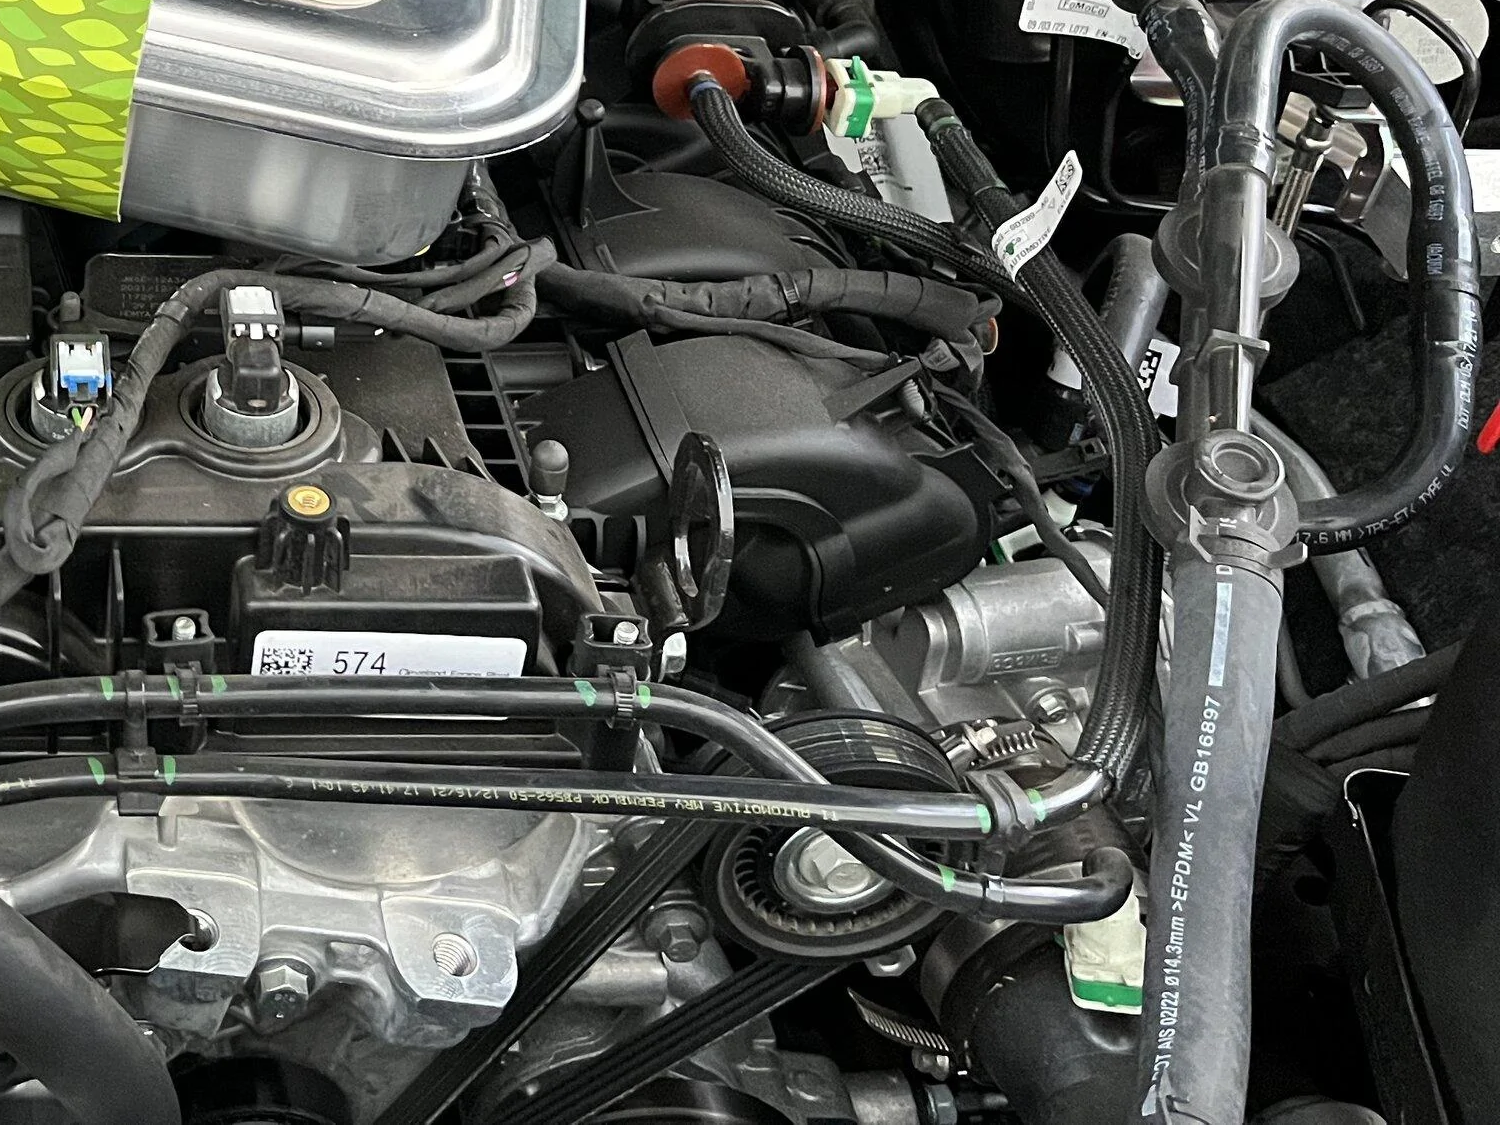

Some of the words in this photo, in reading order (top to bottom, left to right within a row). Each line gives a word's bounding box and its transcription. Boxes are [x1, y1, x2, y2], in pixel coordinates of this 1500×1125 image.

[1062, 0, 1105, 15] FoMoCo
[1008, 227, 1052, 270] AUTOMOTIVE
[1335, 530, 1353, 542] MM
[1418, 477, 1442, 505] TYPE
[332, 651, 387, 675] 574
[1191, 695, 1223, 793] GB16897
[673, 796, 703, 811] MRY
[711, 800, 810, 818] AUTOMOTIVE
[819, 808, 838, 821] TI
[1183, 799, 1203, 825] VL
[1159, 990, 1180, 1027] 02/22
[1157, 1026, 1175, 1050] AIS
